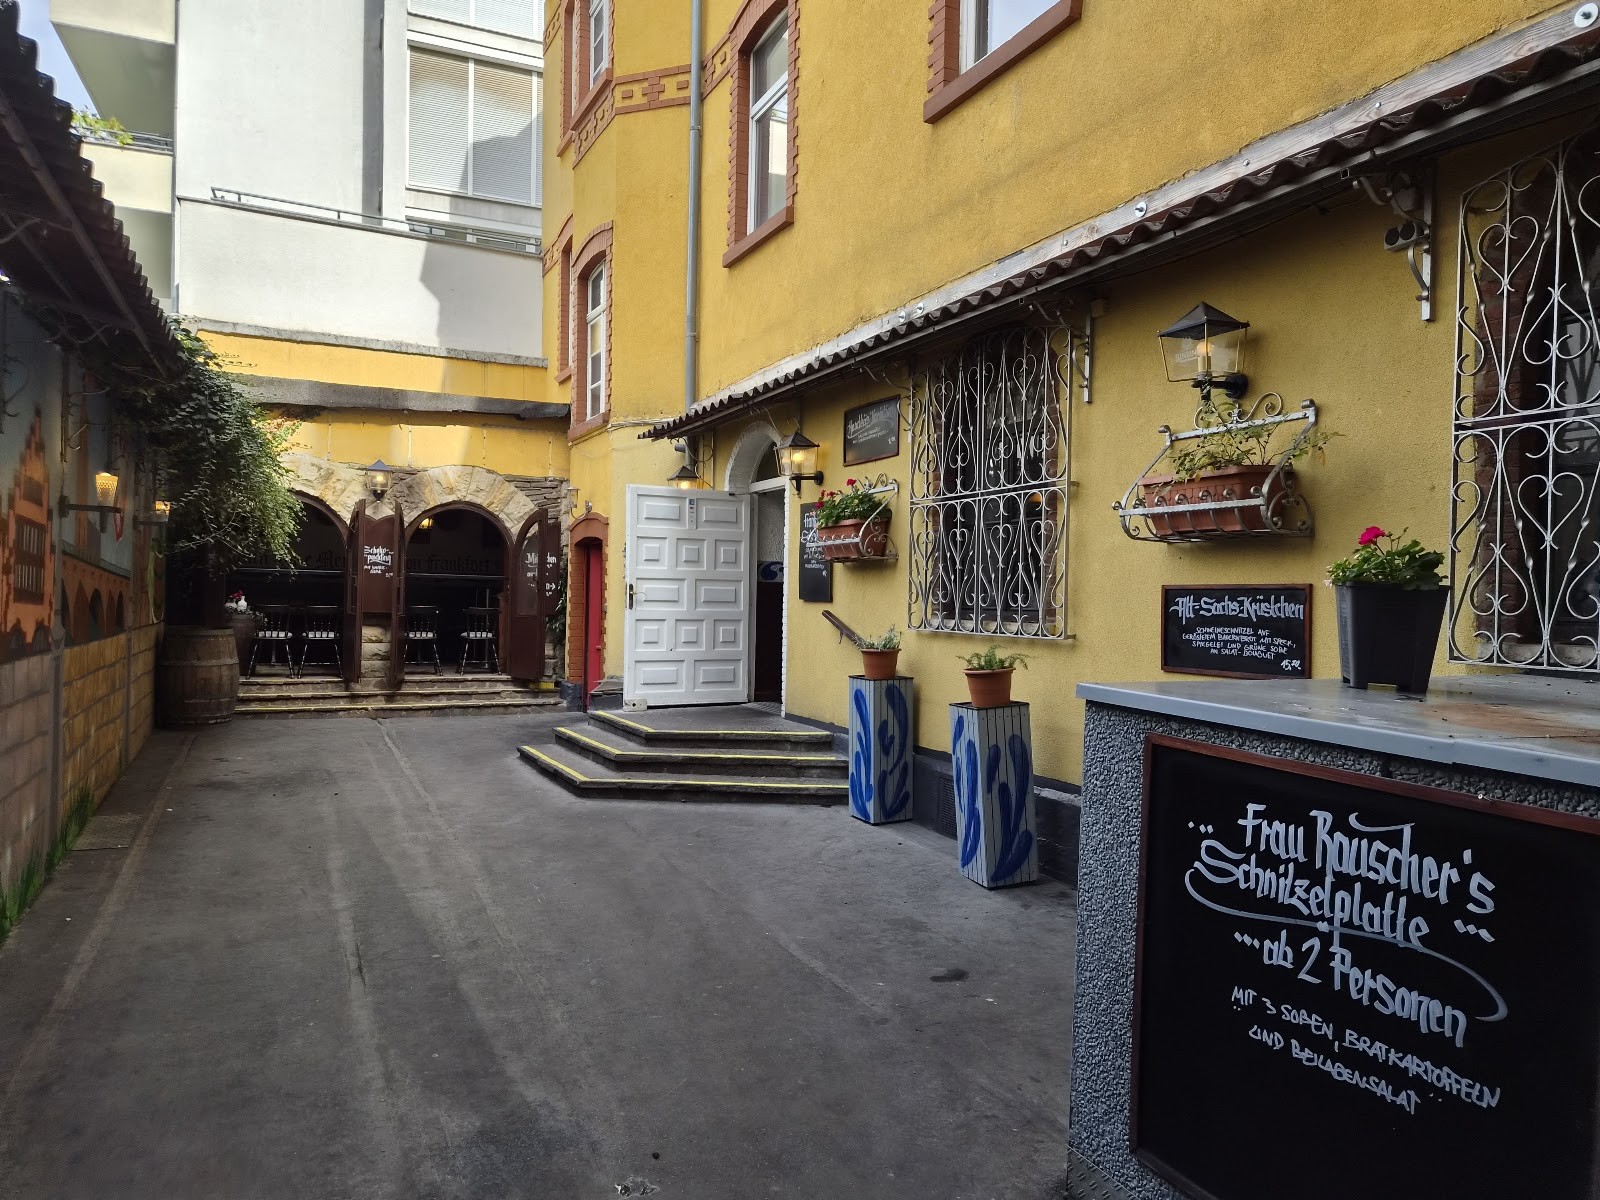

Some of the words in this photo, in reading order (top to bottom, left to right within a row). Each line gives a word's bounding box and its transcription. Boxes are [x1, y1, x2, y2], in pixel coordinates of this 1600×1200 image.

[1227, 642, 1241, 650] UND
[1237, 803, 1308, 863] Frau
[1310, 809, 1496, 915] Rauscher's
[1232, 985, 1257, 1006] MIT
[1261, 997, 1277, 1015] 3
[1342, 1028, 1501, 1108] BRATKARTOFFELN
[1248, 1024, 1285, 1051] UND
[1297, 937, 1322, 984] 2
[1328, 946, 1467, 1048] Personen
